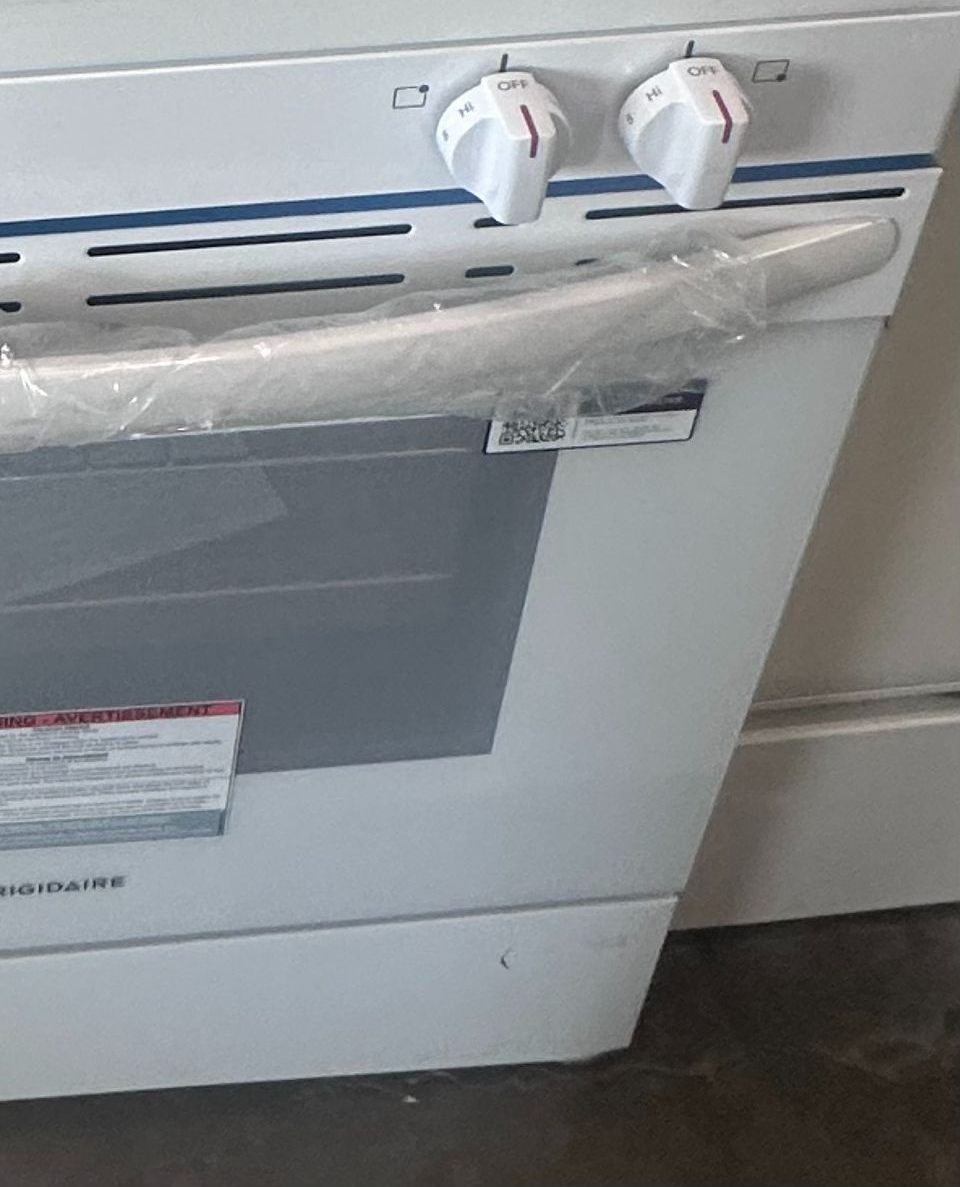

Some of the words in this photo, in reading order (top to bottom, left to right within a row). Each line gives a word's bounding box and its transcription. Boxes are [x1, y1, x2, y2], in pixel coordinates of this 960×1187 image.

[687, 66, 719, 77] OFF
[497, 79, 529, 91] OFF
[53, 705, 210, 724] AVERTISSEMENT
